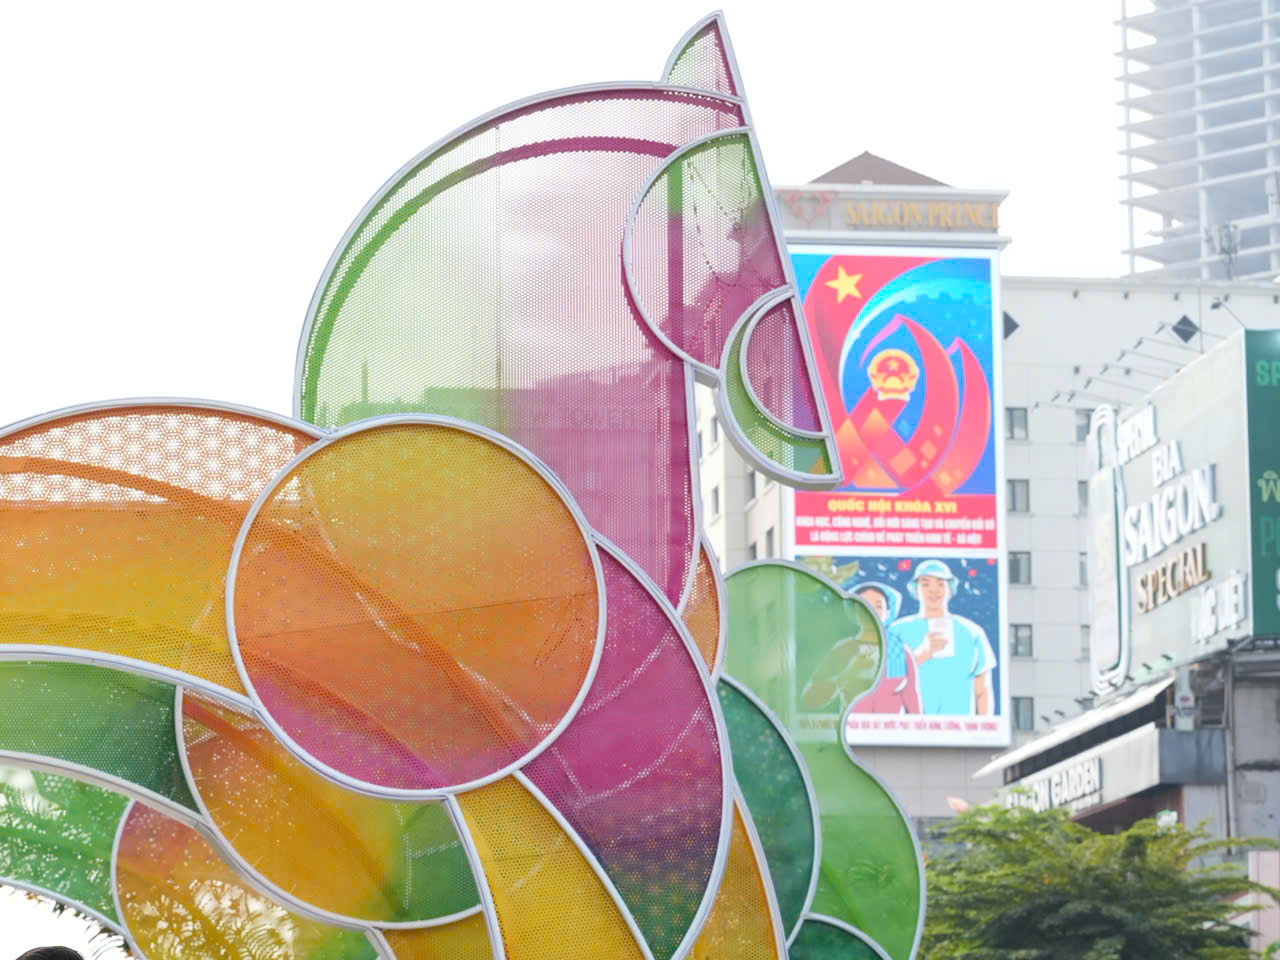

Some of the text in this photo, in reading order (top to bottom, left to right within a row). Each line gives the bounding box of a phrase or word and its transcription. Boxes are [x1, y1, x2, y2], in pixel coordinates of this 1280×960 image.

[827, 497, 865, 512] QUỐC
[894, 498, 932, 513] KHÓA
[934, 501, 958, 513] XVI
[1136, 542, 1210, 615] SPECIAL
